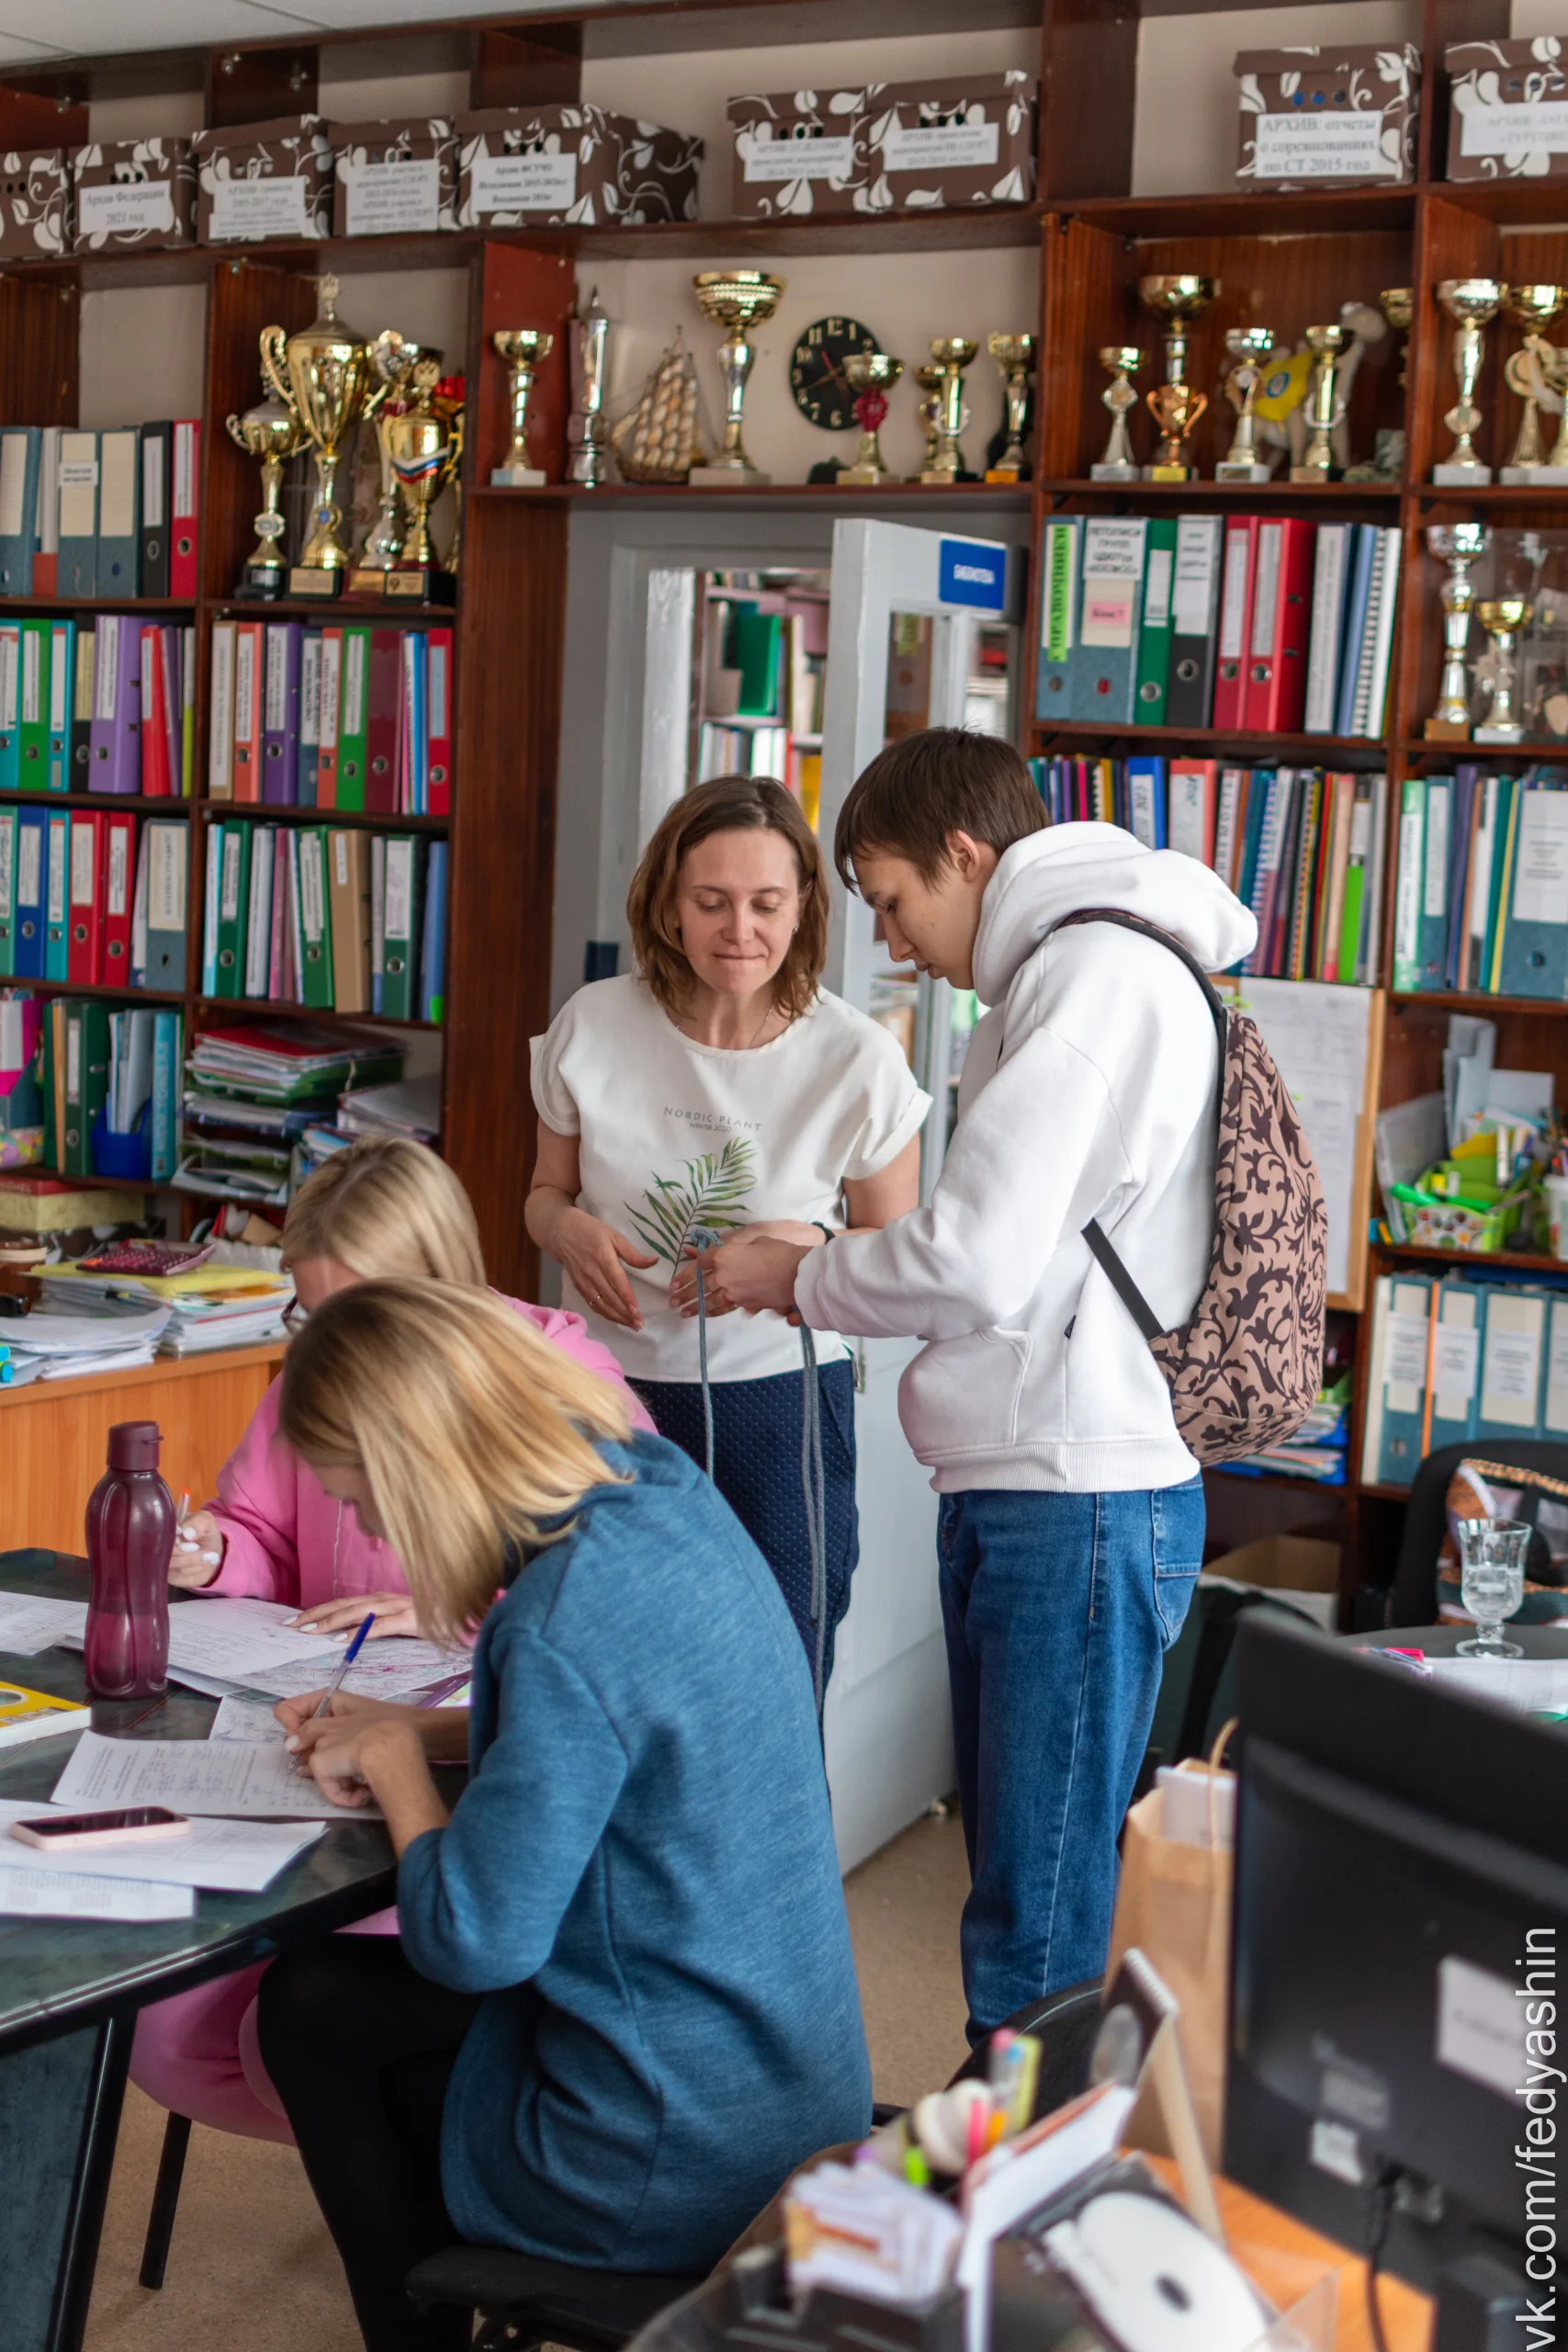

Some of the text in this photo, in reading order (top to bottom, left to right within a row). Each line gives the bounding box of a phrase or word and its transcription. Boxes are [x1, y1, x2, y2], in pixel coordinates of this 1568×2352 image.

[809, 326, 823, 345] 11
[828, 318, 843, 336] 12
[849, 322, 857, 341] 1
[809, 402, 821, 421] 7
[830, 409, 842, 428] 6
[663, 1106, 762, 1132] NORDIC PLANT
[689, 1122, 732, 1133] WINTER 2020
